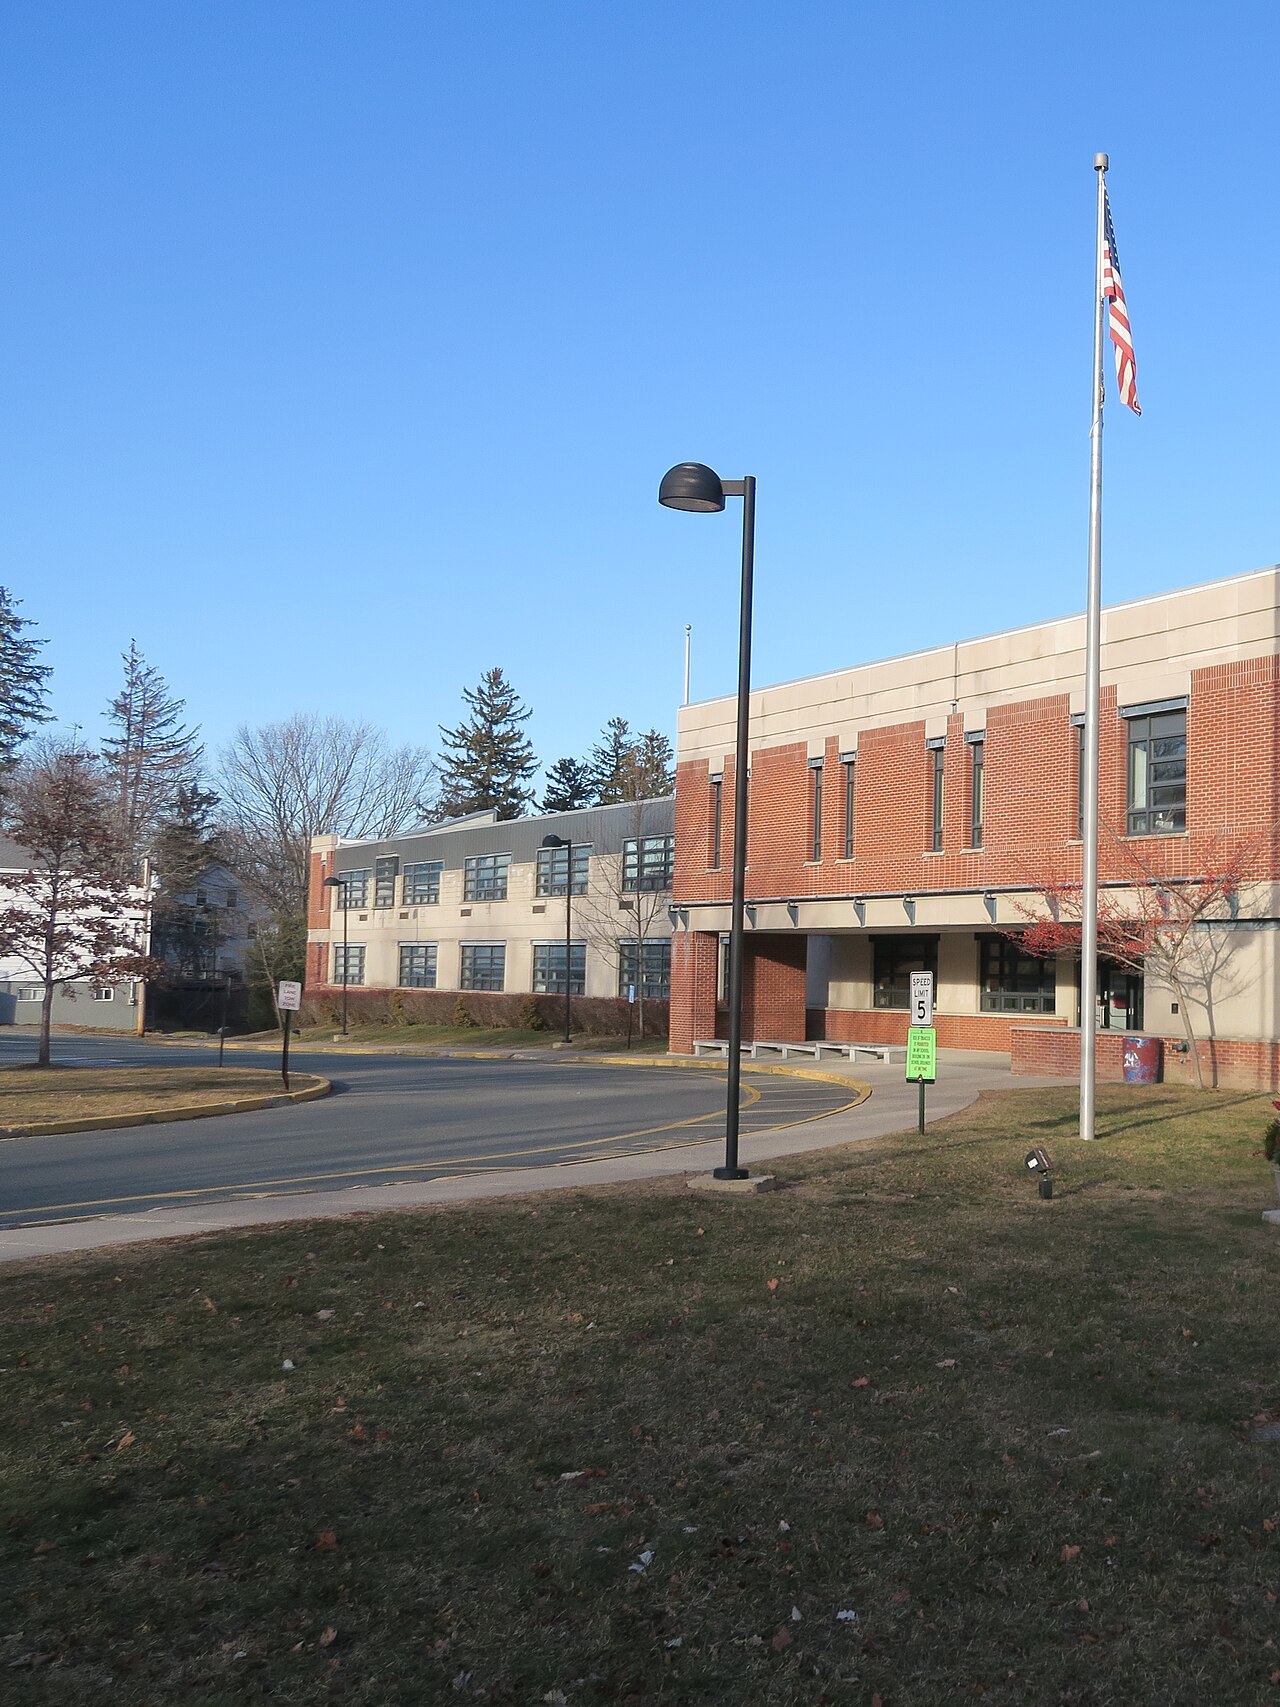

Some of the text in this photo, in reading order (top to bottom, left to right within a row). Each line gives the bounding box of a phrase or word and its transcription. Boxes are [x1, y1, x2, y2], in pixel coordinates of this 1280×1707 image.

[912, 978, 931, 986] SPEED
[914, 989, 929, 998] LIMIT
[917, 1000, 926, 1020] 5
